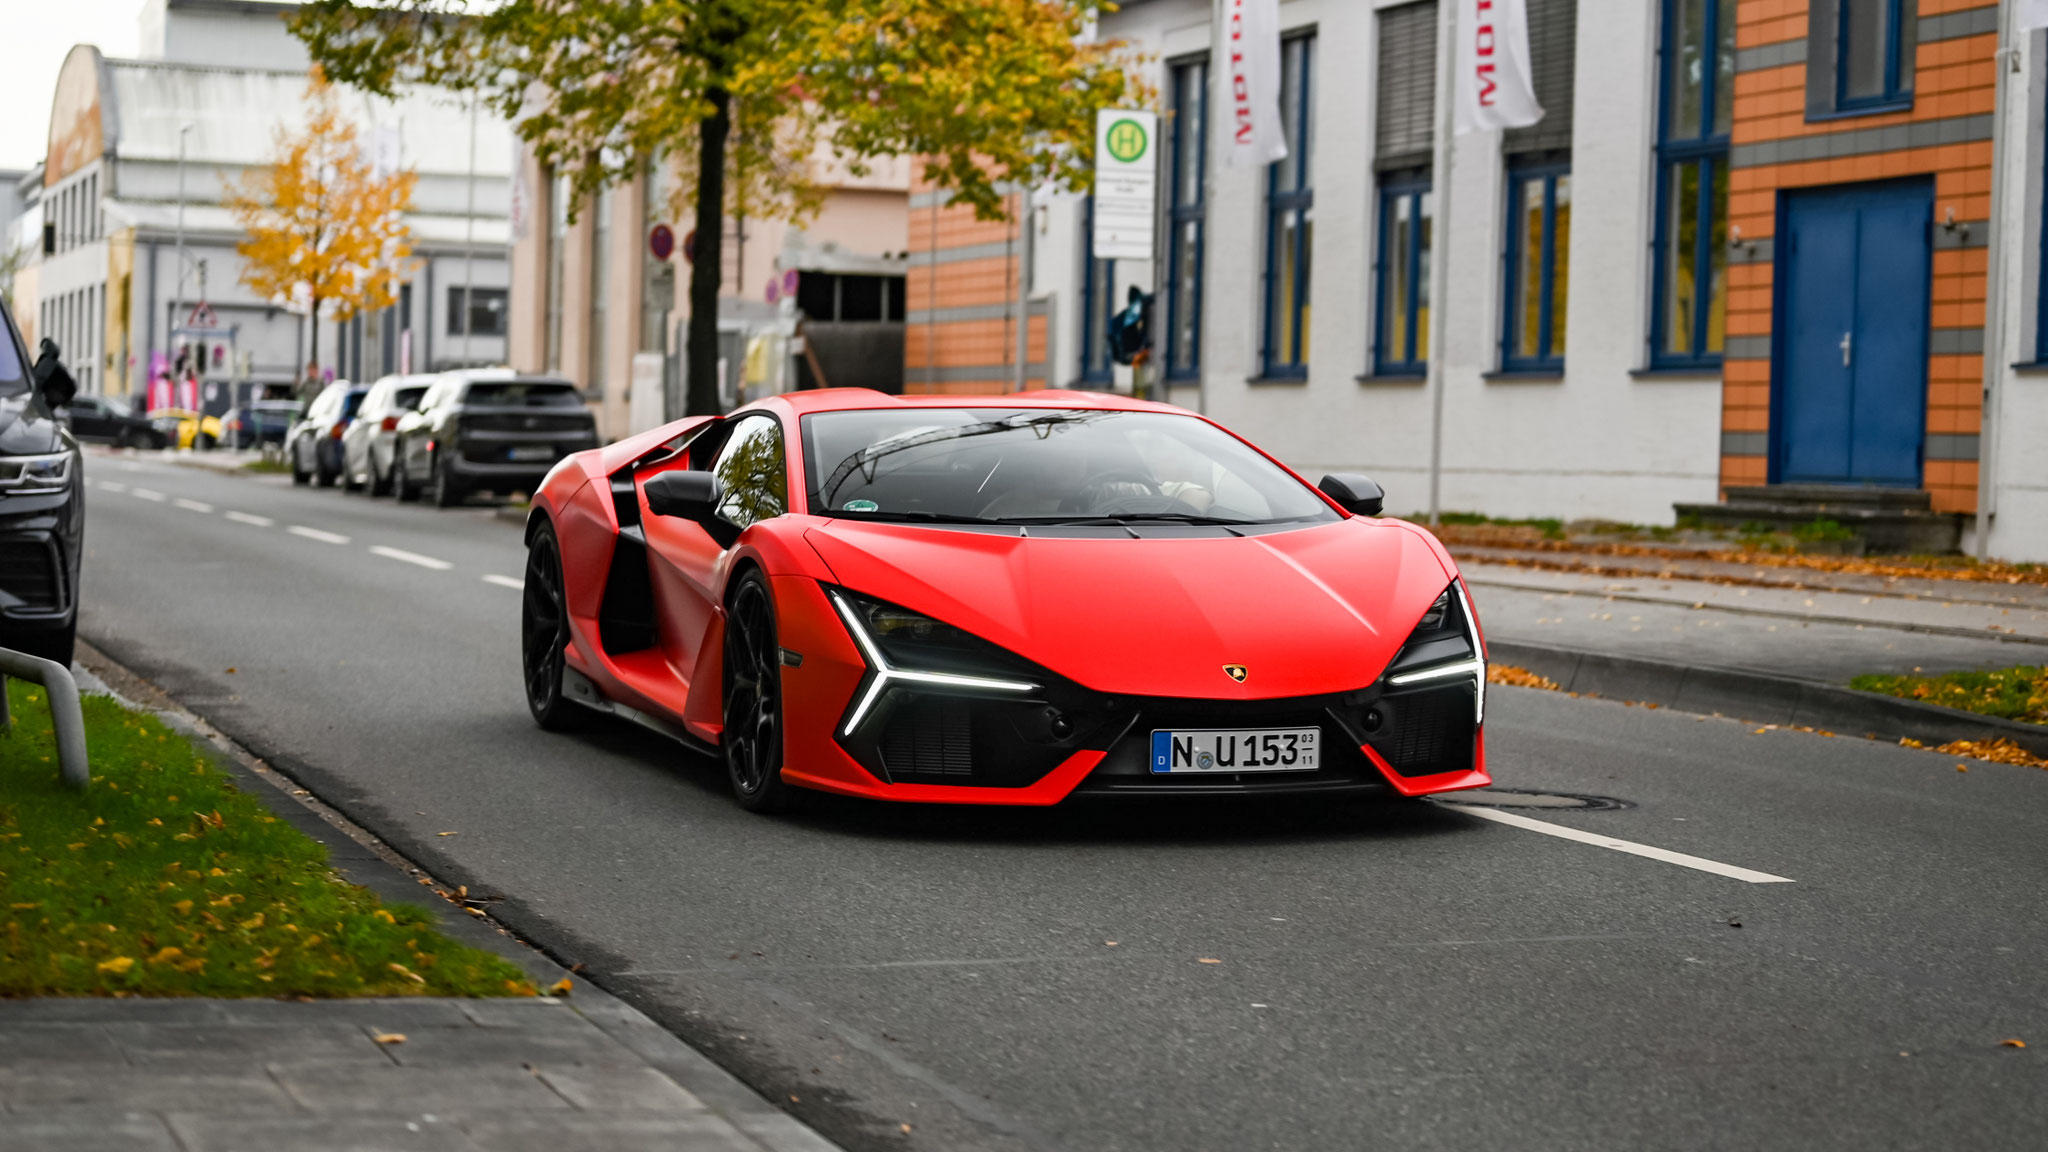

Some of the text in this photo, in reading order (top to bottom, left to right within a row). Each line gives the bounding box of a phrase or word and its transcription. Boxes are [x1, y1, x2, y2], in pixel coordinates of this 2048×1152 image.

[1118, 127, 1136, 153] H
[1301, 733, 1314, 743] 03
[1172, 734, 1298, 767] N U 153
[1158, 755, 1166, 766] D
[1302, 755, 1313, 765] 11
